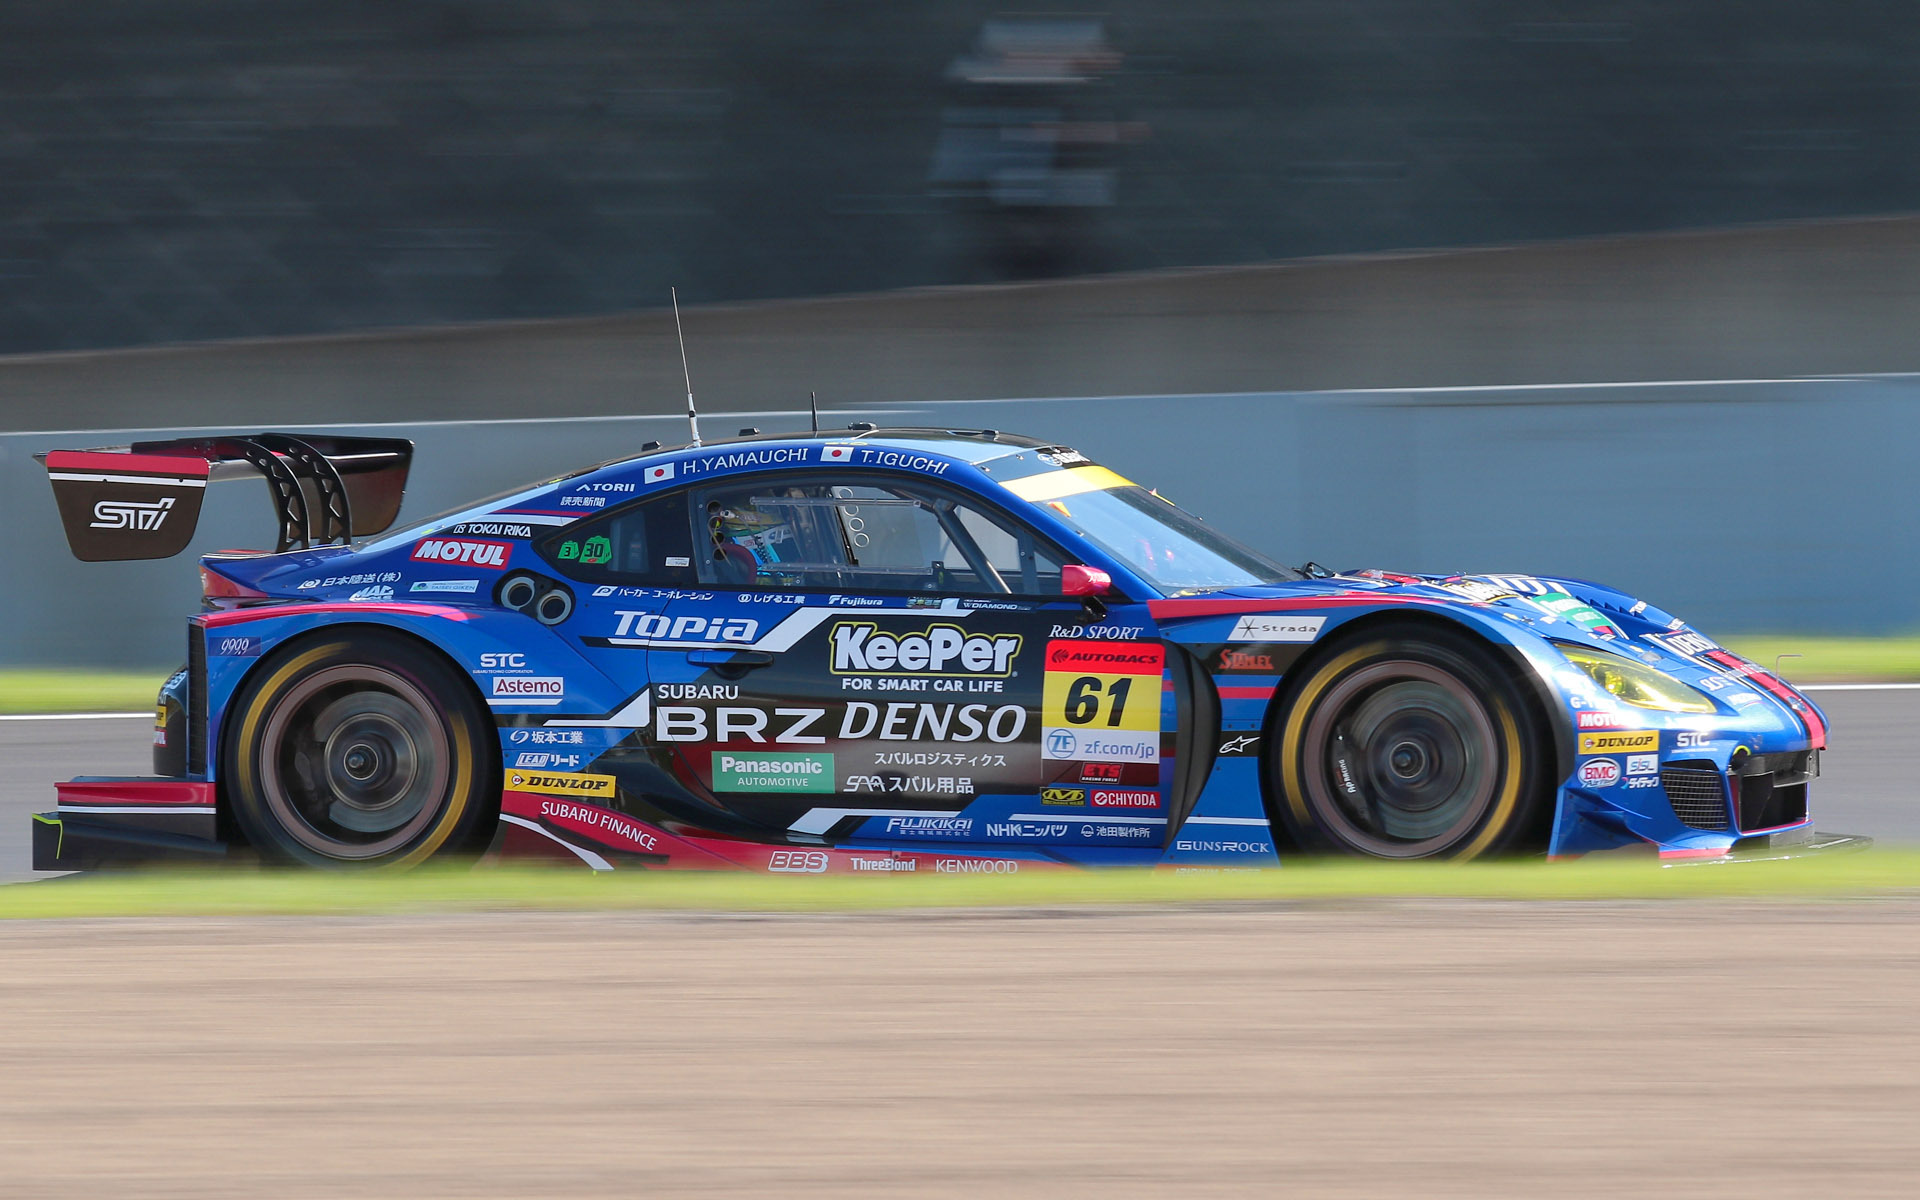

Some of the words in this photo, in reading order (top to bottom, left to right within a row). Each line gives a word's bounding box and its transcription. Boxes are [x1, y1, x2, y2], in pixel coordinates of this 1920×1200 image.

[683, 448, 808, 474] H.YAMAUCHI
[860, 449, 949, 475] T.IGUCHI
[592, 483, 635, 492] TORII
[560, 496, 606, 507] 読売新聞
[468, 524, 503, 536] TOKAI
[504, 525, 532, 537] RIKA
[414, 540, 506, 566] MOTUL
[564, 546, 571, 556] 3
[584, 543, 604, 558] 30
[618, 588, 649, 598] パーカー
[652, 589, 714, 601] コーポレーション
[753, 594, 805, 605] しげる工業
[839, 596, 883, 607] Fujikura
[1048, 624, 1084, 638] R&D
[1086, 625, 1143, 640] SPORT
[1262, 624, 1317, 633] Strada
[834, 626, 1018, 672] KeePer
[480, 653, 526, 668] STC
[1070, 652, 1160, 664] AUTOBACS
[495, 678, 562, 693] Astemo
[657, 684, 739, 700] SUBARU
[841, 678, 873, 691] FOR
[878, 678, 930, 692] SMART
[933, 679, 964, 692] CAR
[968, 680, 1004, 693] LIFE
[1064, 676, 1132, 727] 61
[656, 706, 826, 744] BRZ
[837, 701, 1027, 743] DENSO
[531, 730, 583, 744] 坂本工業
[1596, 736, 1654, 748] DUNLOP
[1676, 732, 1710, 747] STC
[1049, 735, 1072, 752] ZF
[1084, 741, 1155, 758] zf.com/jp
[518, 754, 547, 765] LEAD
[550, 754, 580, 767] リード
[721, 756, 823, 774] Panasonic
[874, 752, 1007, 767] スバルロジスティクス
[1083, 763, 1121, 778] ETS
[1585, 766, 1617, 780] BMC
[526, 775, 609, 790] DUNLOP
[737, 777, 809, 787] AUTOMOTIVE
[889, 777, 974, 795] スバル用品
[1107, 791, 1157, 807] CHIYODA
[540, 801, 599, 825] SUBARU
[599, 815, 658, 851] FINANCE
[886, 818, 973, 833] FUJIKIKAI
[1096, 826, 1151, 839] 池田製作所
[767, 850, 829, 873] BBS
[850, 858, 916, 872] ThreeBond
[935, 860, 1019, 874] KENWOOD
